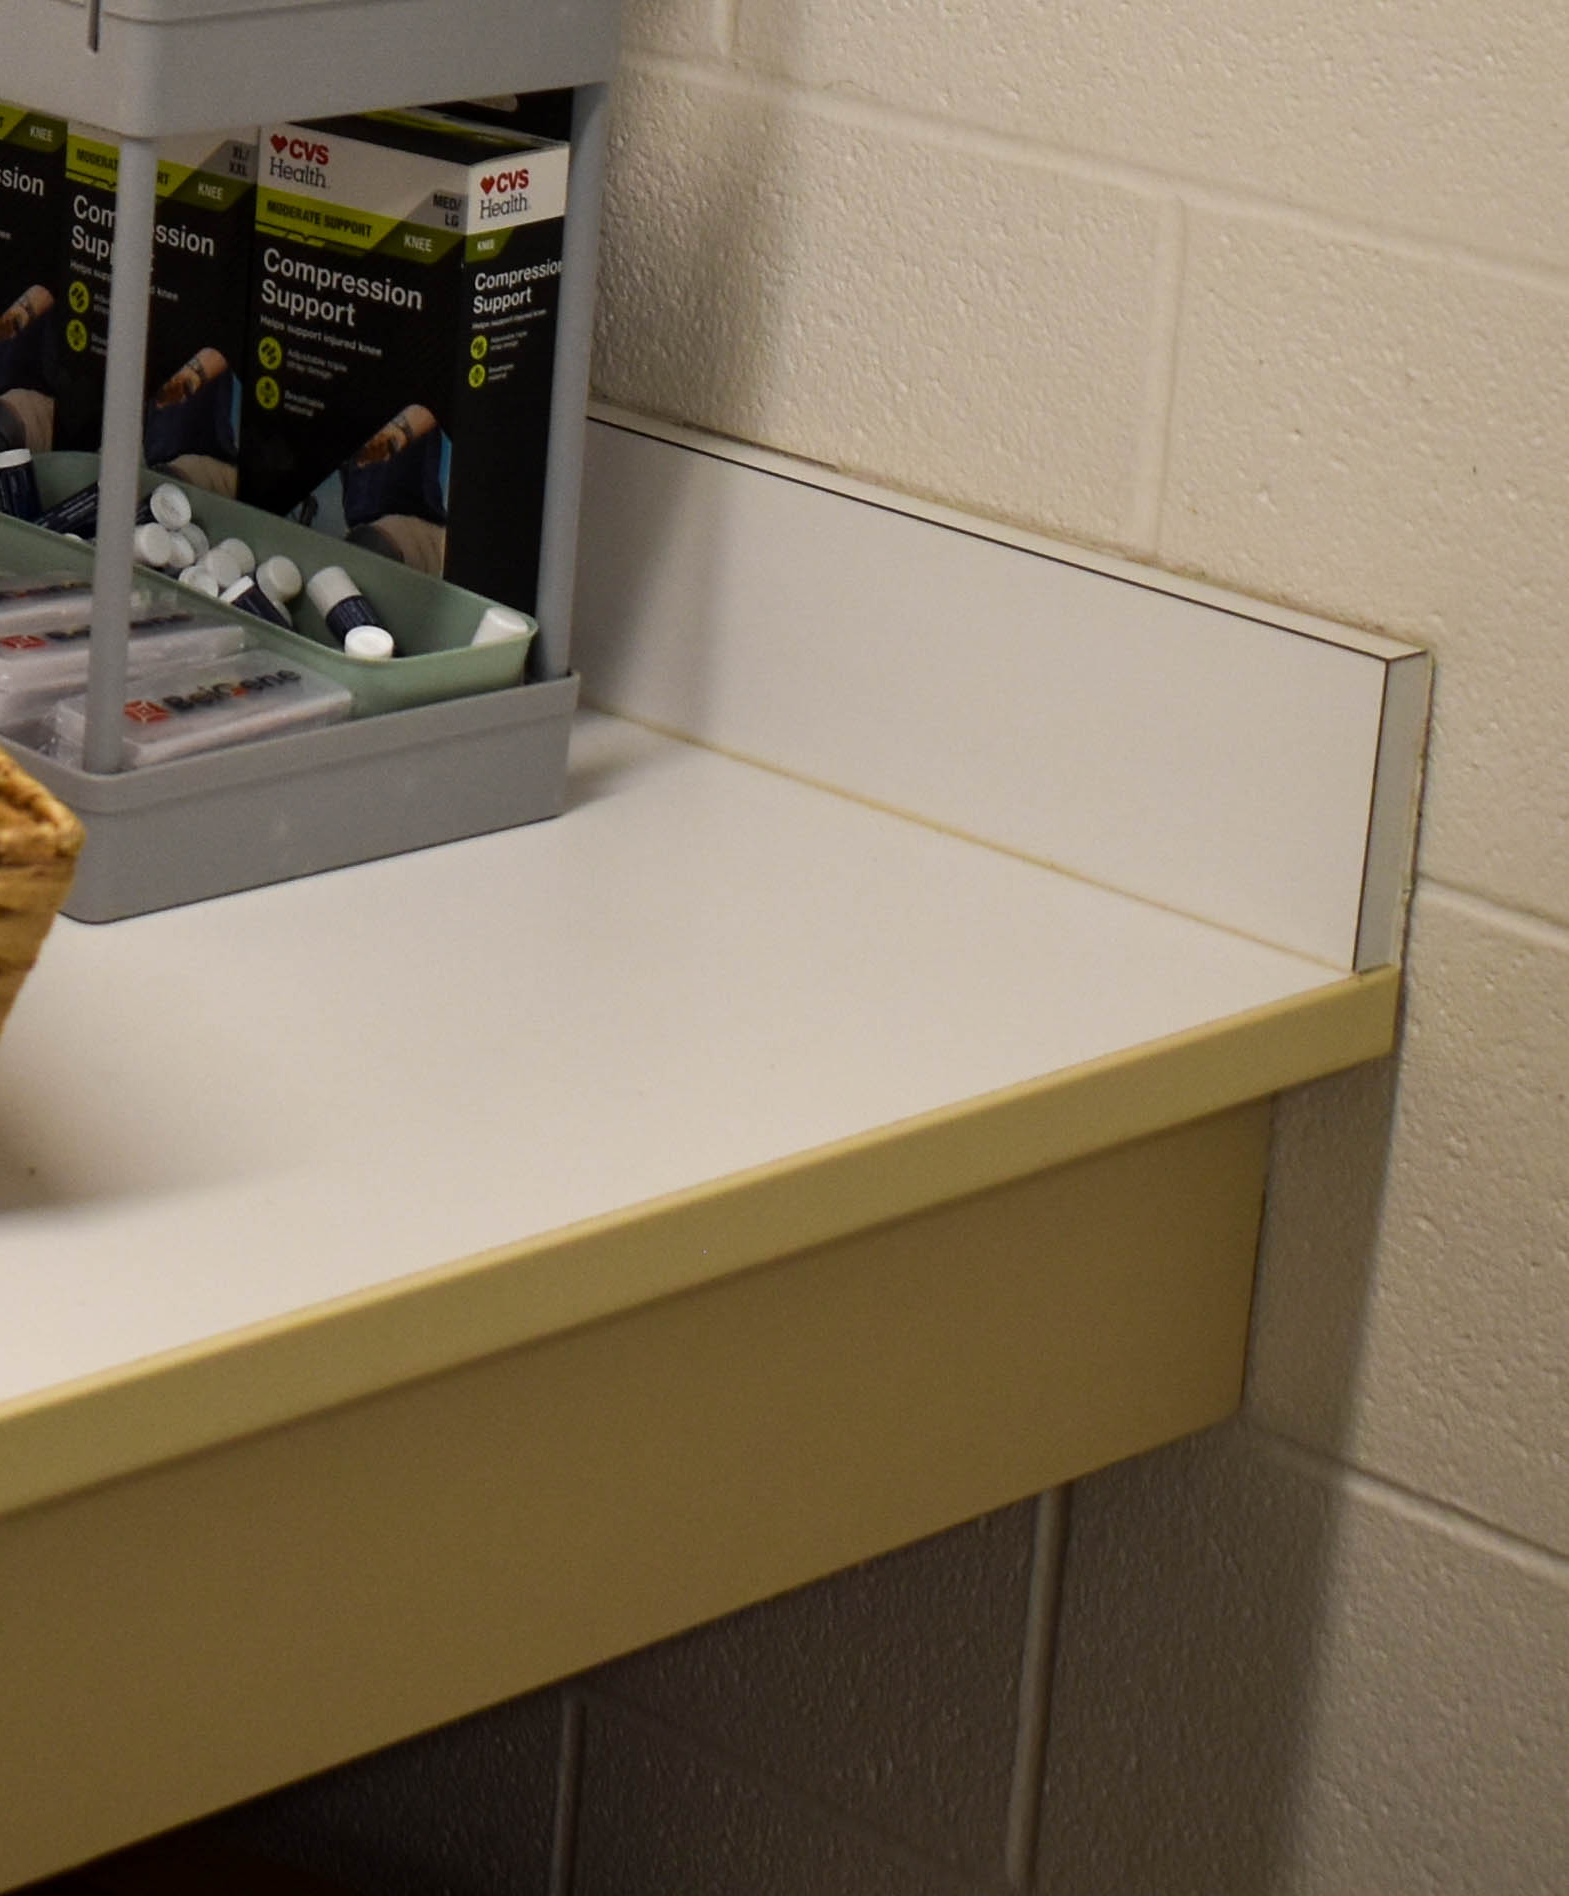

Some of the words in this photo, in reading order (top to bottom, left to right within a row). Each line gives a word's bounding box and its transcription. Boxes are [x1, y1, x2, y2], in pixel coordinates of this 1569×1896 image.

[29, 125, 54, 143] KNEE
[76, 148, 119, 172] MODERAT
[289, 138, 330, 166] CVS
[269, 156, 327, 189] Health
[496, 169, 530, 193] CVS
[197, 182, 224, 201] KNEE
[266, 200, 321, 225] MODERATE
[323, 213, 373, 238] SUPPORT
[479, 193, 528, 219] Health
[73, 195, 215, 256] Comssion
[444, 214, 461, 228] LG
[404, 234, 433, 253] KNEE
[263, 247, 423, 311] Compression
[261, 279, 356, 327] Support
[473, 286, 532, 314] Support
